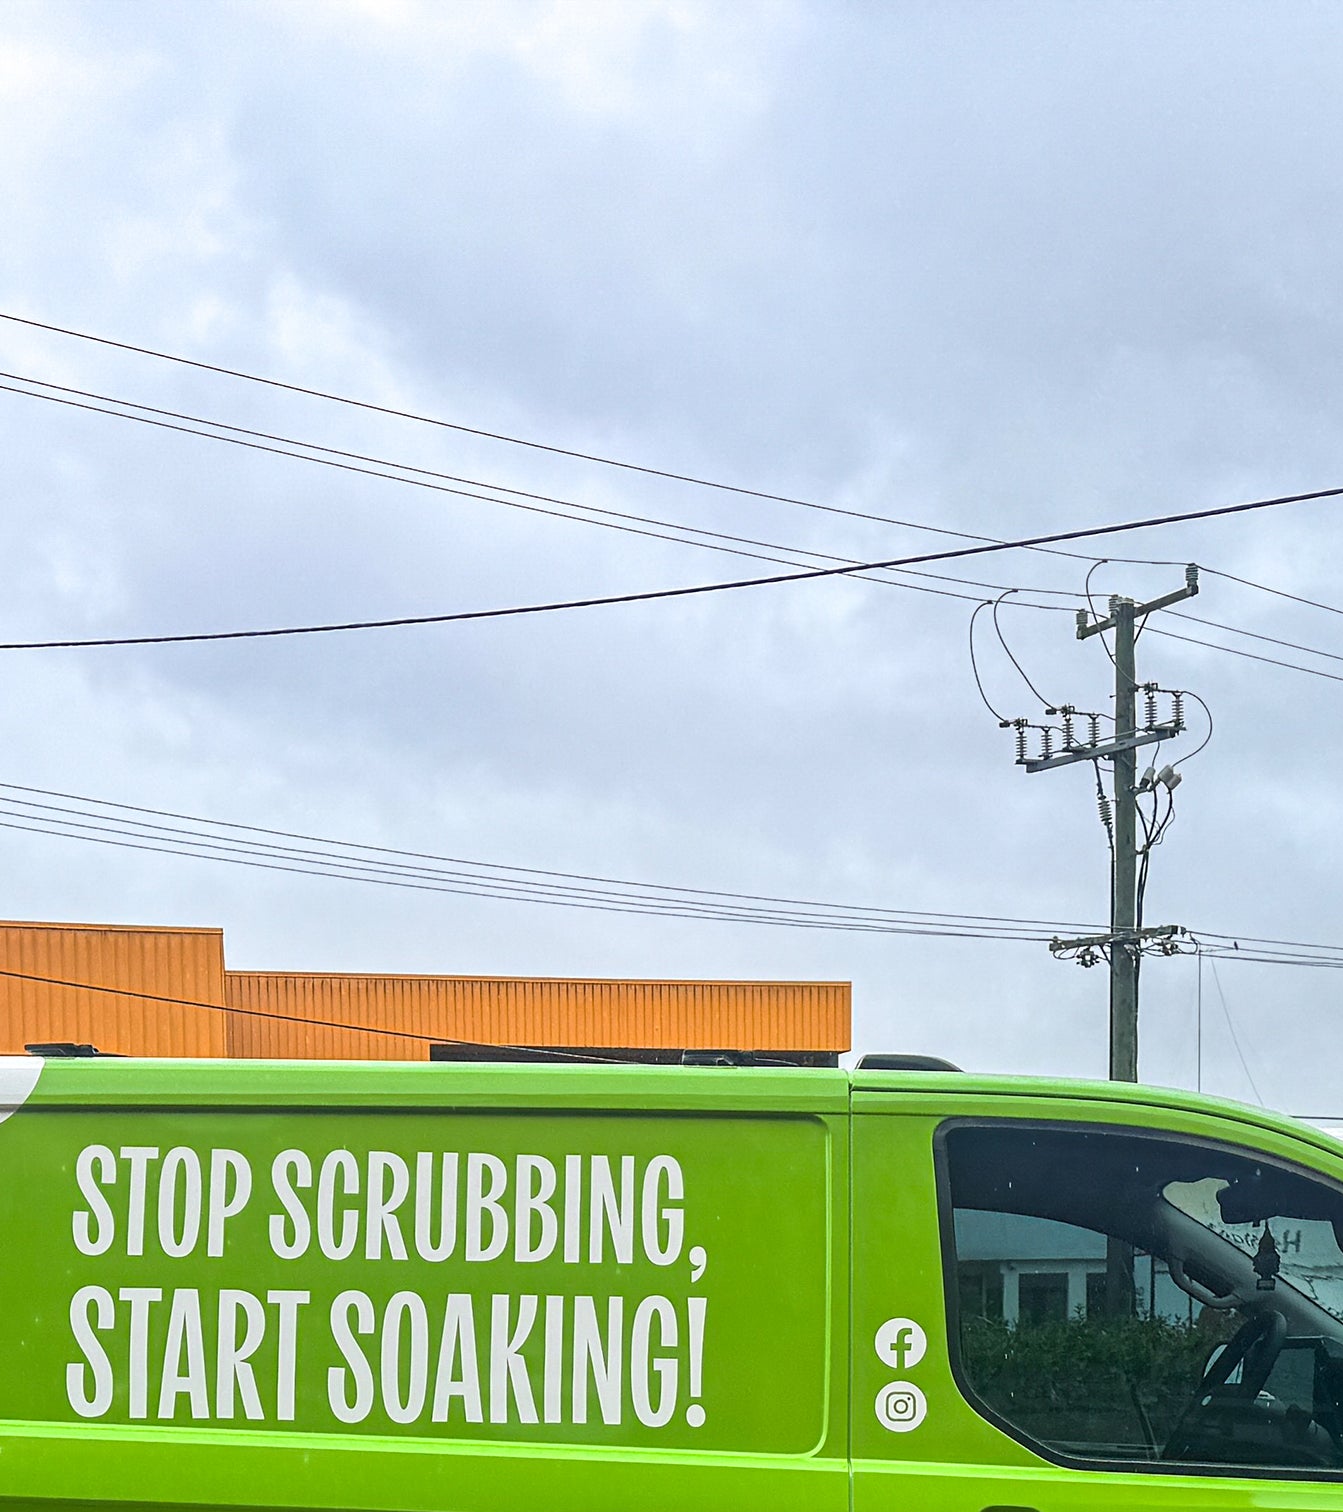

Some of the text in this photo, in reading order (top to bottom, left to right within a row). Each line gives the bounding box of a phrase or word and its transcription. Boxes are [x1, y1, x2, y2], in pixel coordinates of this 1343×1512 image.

[71, 1144, 708, 1283] STOP SCRUBBING,
[65, 1285, 708, 1426] START SOAKING!
